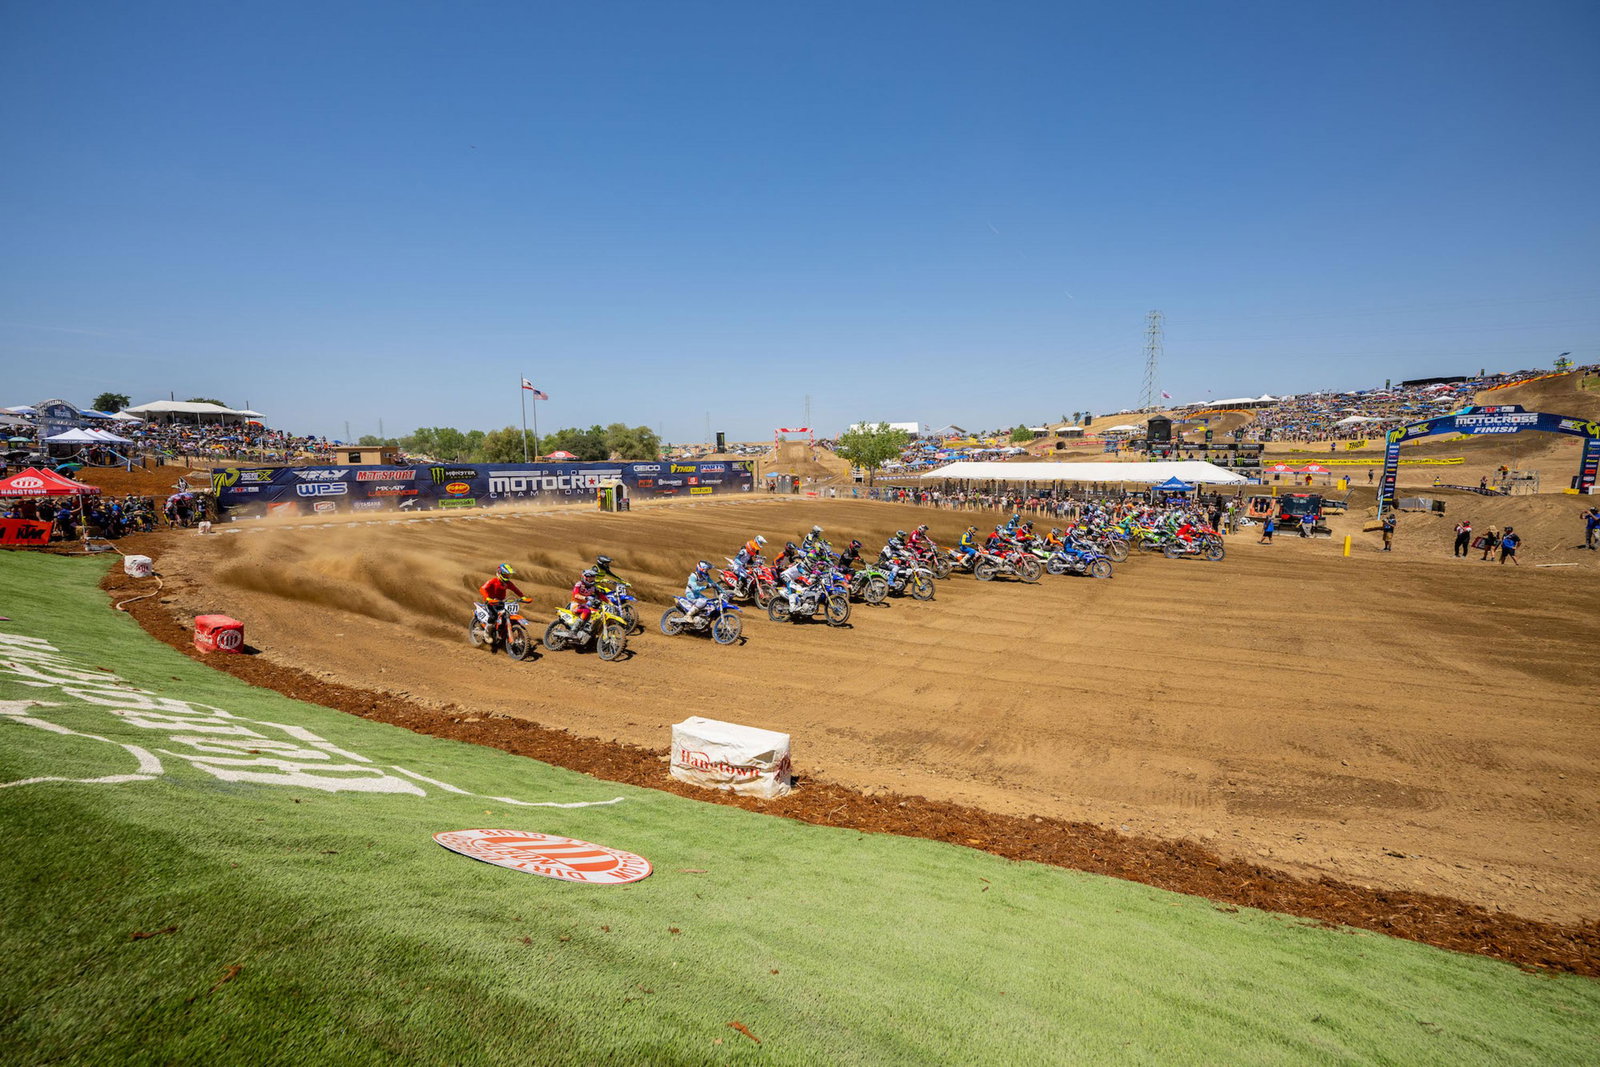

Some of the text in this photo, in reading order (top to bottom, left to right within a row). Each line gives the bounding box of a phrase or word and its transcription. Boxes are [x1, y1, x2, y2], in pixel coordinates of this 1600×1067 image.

[1455, 415, 1538, 425] MOTOCROSS
[633, 464, 661, 472] GEICO
[677, 465, 696, 473] THOR
[489, 475, 622, 492] MOTOCRO
[296, 482, 348, 497] WPS
[490, 489, 595, 498] CHAMPIONS
[16, 525, 46, 539] KTM
